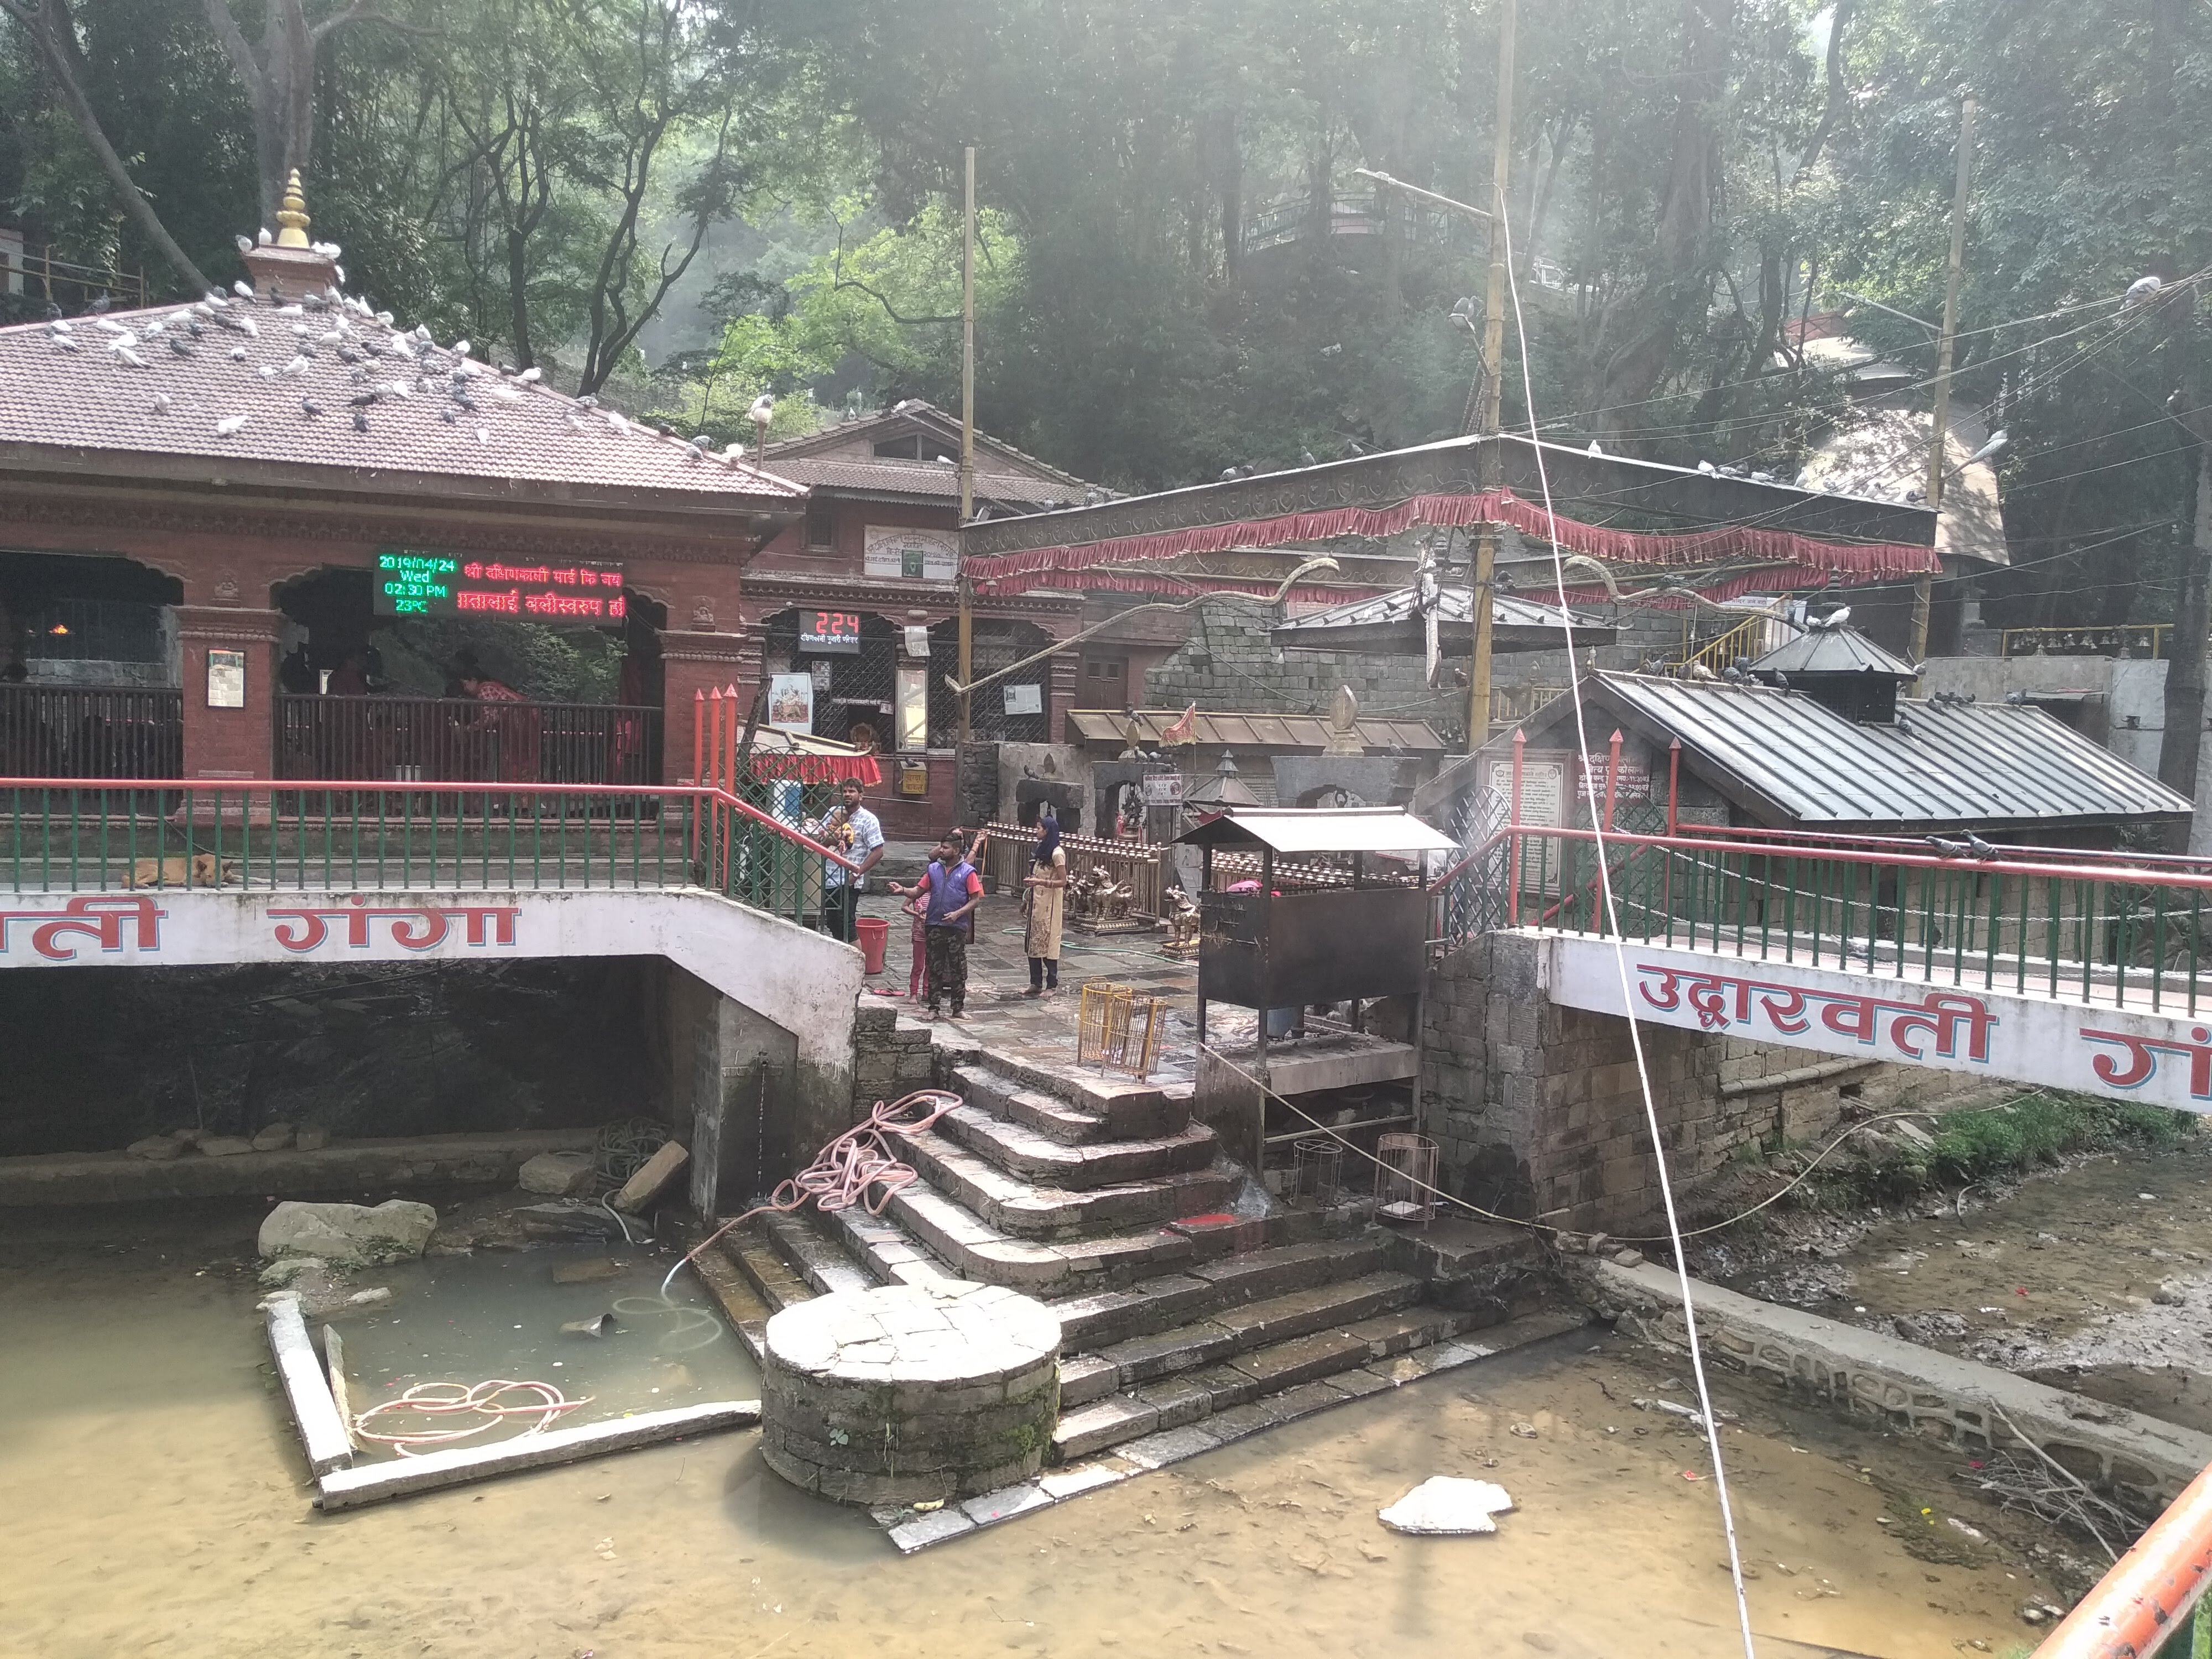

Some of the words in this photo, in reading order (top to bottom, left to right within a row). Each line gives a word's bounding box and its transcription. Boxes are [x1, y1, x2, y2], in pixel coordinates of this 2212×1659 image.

[399, 570, 430, 583] Wed
[385, 583, 423, 596] 02:30
[426, 585, 446, 597] PM
[816, 612, 859, 634] 224
[800, 632, 825, 642] दक्षिणकाली
[0, 896, 168, 961] ती
[267, 895, 522, 952] गंगा
[2079, 1026, 2212, 1101] गं
